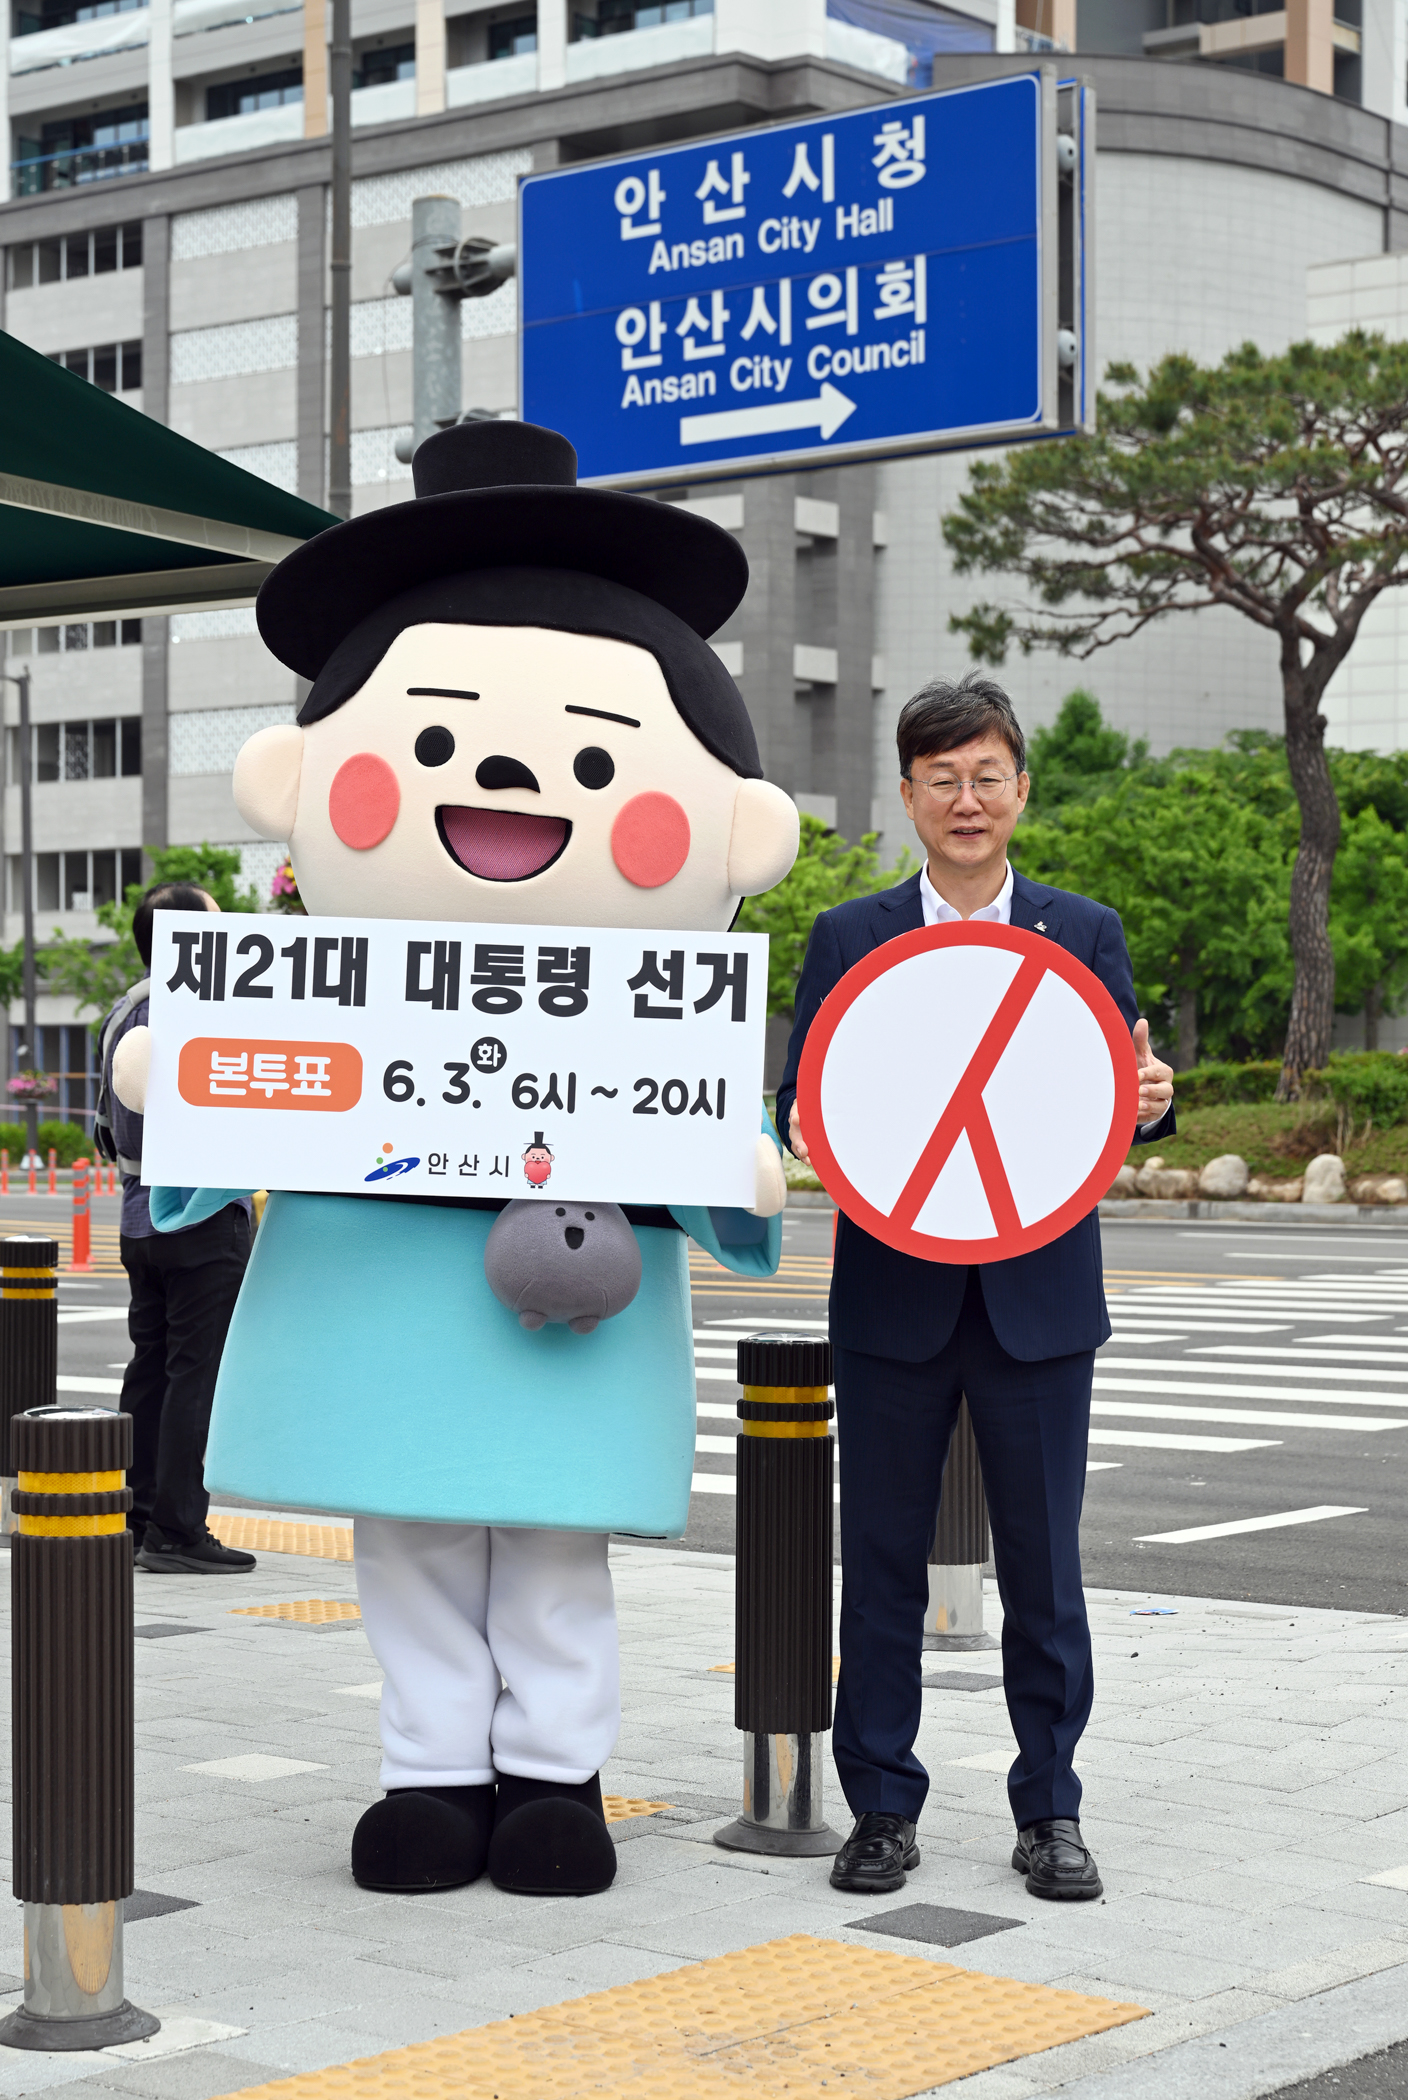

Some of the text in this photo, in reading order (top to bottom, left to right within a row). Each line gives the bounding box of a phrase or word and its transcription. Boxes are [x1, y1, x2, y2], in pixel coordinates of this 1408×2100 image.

[648, 196, 894, 275] Ansan City Hall
[615, 253, 927, 371] 안산시의회
[621, 329, 926, 409] Ansan City Council
[165, 930, 749, 1023] 제21대 대통령 선거
[208, 1049, 332, 1099] 본투표
[511, 1072, 577, 1114] 6시
[632, 1077, 726, 1120] 20시
